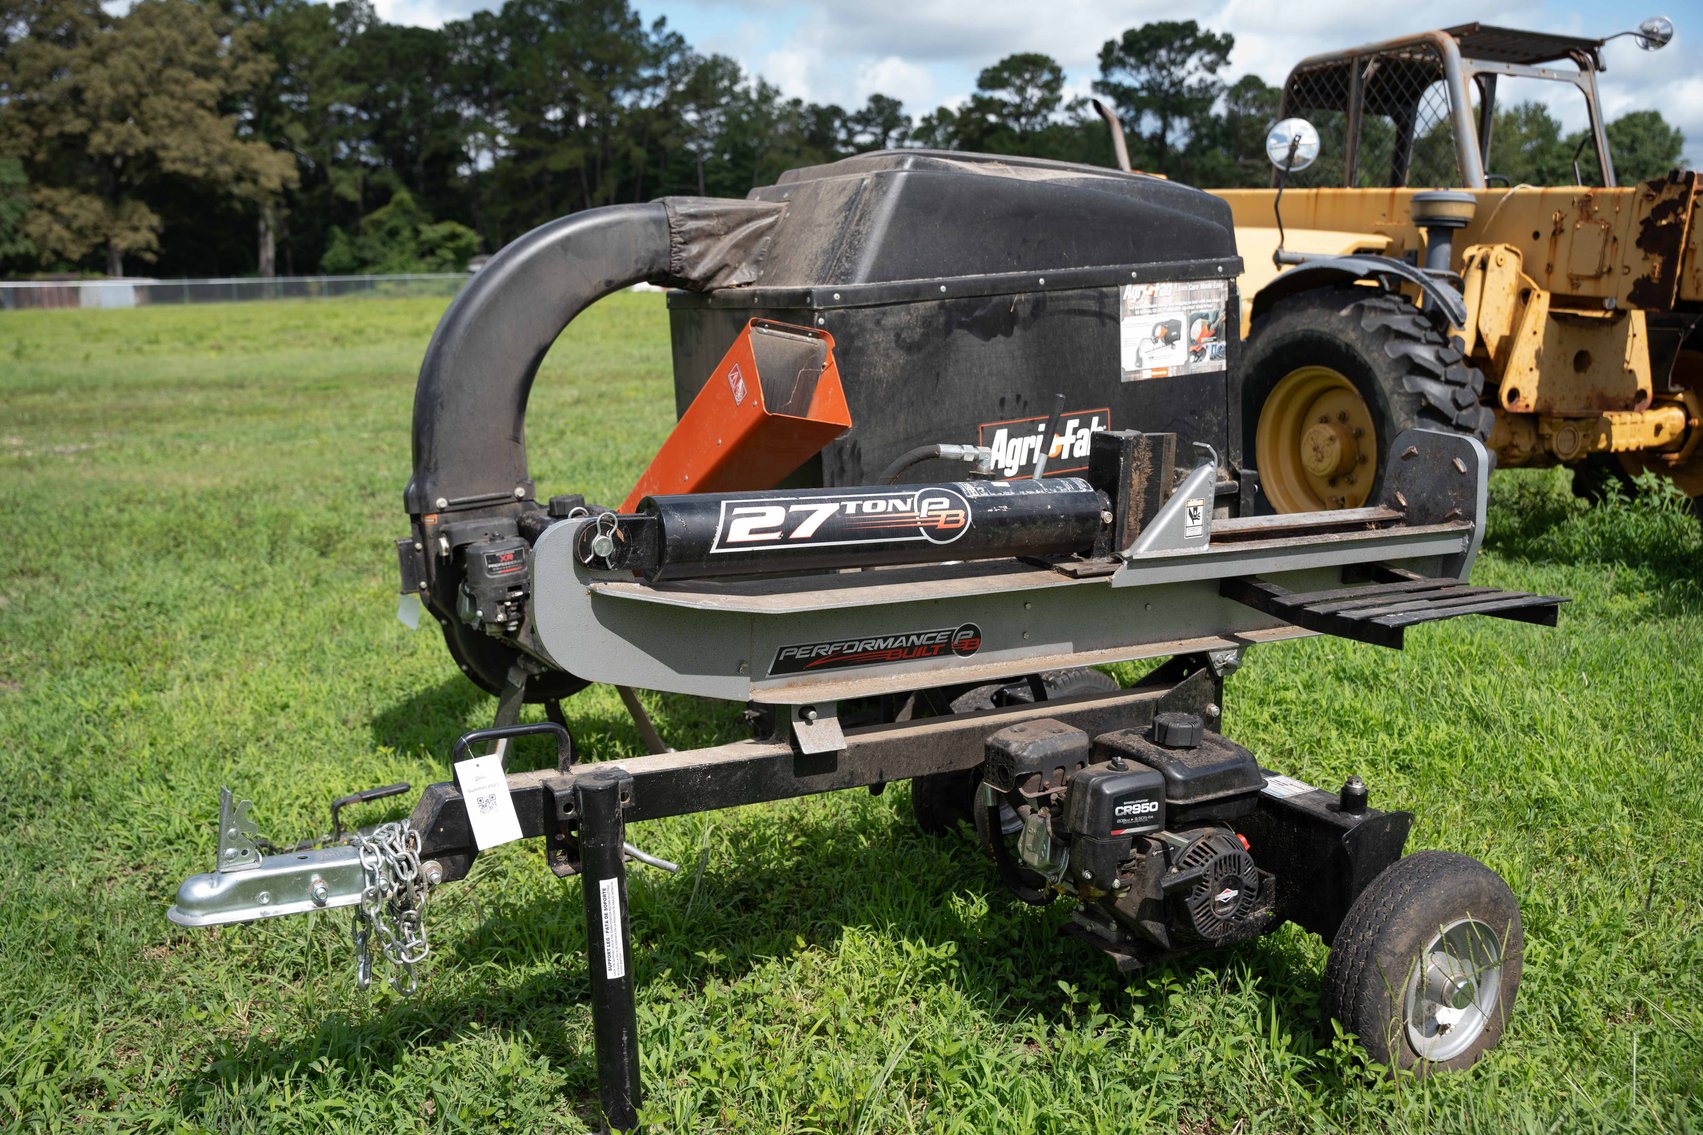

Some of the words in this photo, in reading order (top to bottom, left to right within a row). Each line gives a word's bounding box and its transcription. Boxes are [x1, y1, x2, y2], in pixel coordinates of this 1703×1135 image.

[726, 502, 840, 543] 27
[839, 498, 914, 514] TON
[779, 631, 952, 661] PERFORMANCE
[885, 644, 946, 661] BUILT
[1115, 802, 1159, 816] CR950
